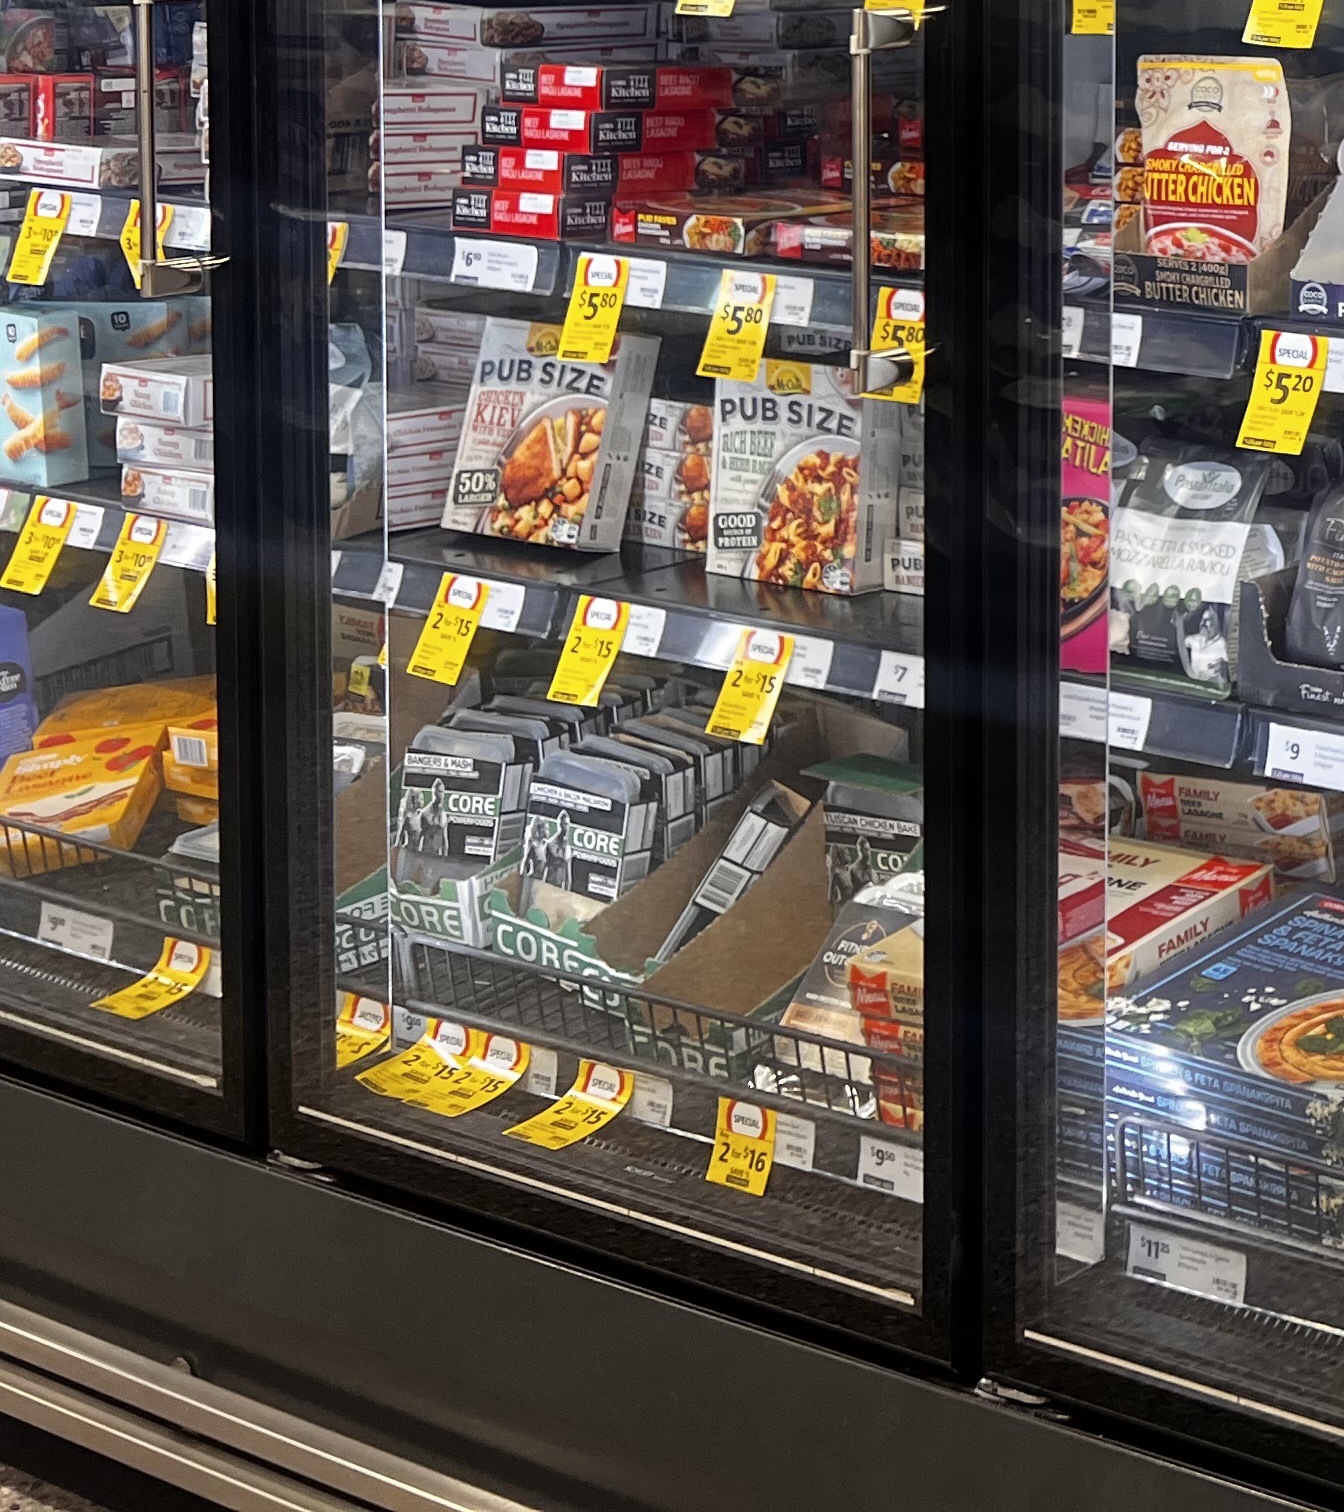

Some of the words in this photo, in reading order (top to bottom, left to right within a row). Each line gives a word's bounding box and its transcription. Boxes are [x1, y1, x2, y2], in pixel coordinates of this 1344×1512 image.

[1189, 176, 1257, 207] CHICKEN
[1144, 284, 1190, 305] BUTTER
[1191, 289, 1245, 309] CHICKEN
[1278, 346, 1309, 361] SPECIAL
[480, 358, 534, 385] PUB
[539, 363, 606, 396] SIZE
[720, 395, 782, 427] PUB
[786, 402, 856, 436] SIZE
[718, 513, 757, 530] GOOD
[718, 532, 760, 548] PROTEIN
[406, 756, 442, 768] BANGERS
[450, 758, 472, 769] MASH
[448, 794, 496, 816] CORE
[573, 829, 620, 856] CORE
[718, 1141, 731, 1163] 2
[732, 1145, 742, 1157] for
[743, 1146, 767, 1173] $16
